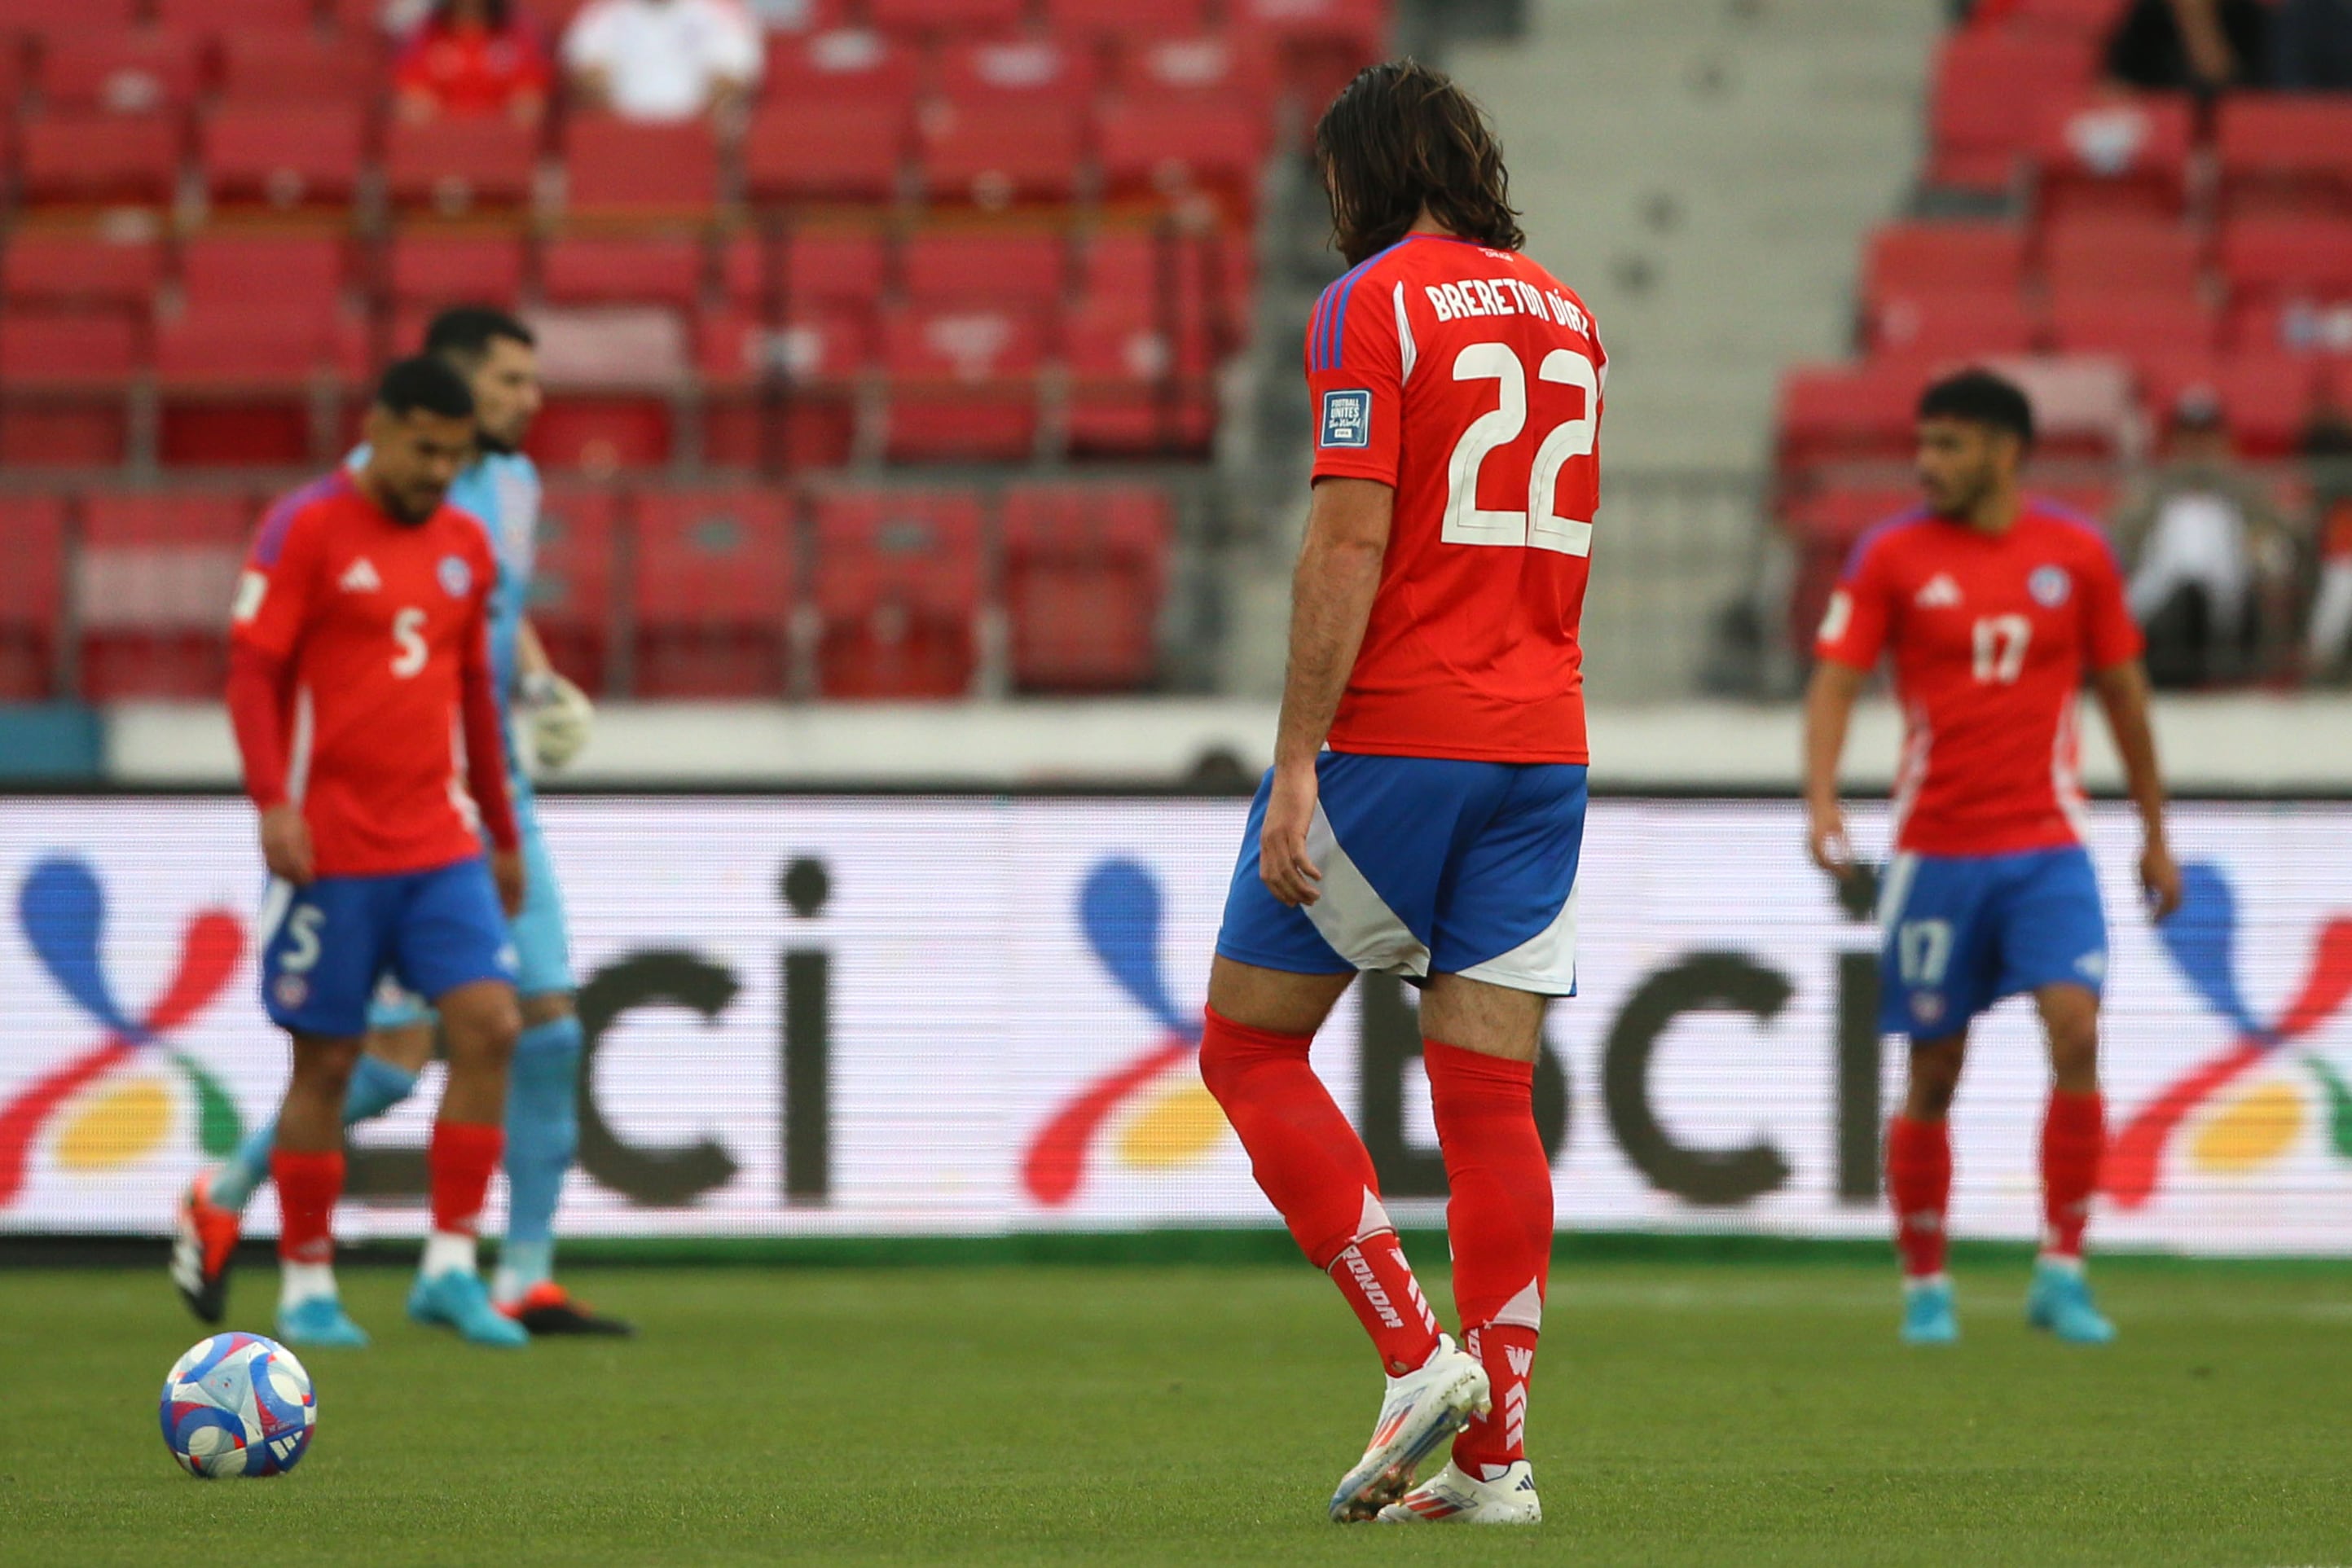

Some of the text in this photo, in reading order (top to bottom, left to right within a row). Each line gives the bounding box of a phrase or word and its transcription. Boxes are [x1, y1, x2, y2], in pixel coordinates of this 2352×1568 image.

[1425, 278, 1550, 323] BRERETON
[1330, 407, 1360, 418] UNITES
[1440, 341, 1594, 558] 22
[389, 607, 429, 679] 5
[1972, 612, 2031, 686] 17
[281, 905, 326, 970] 5
[1899, 920, 1953, 985] 17
